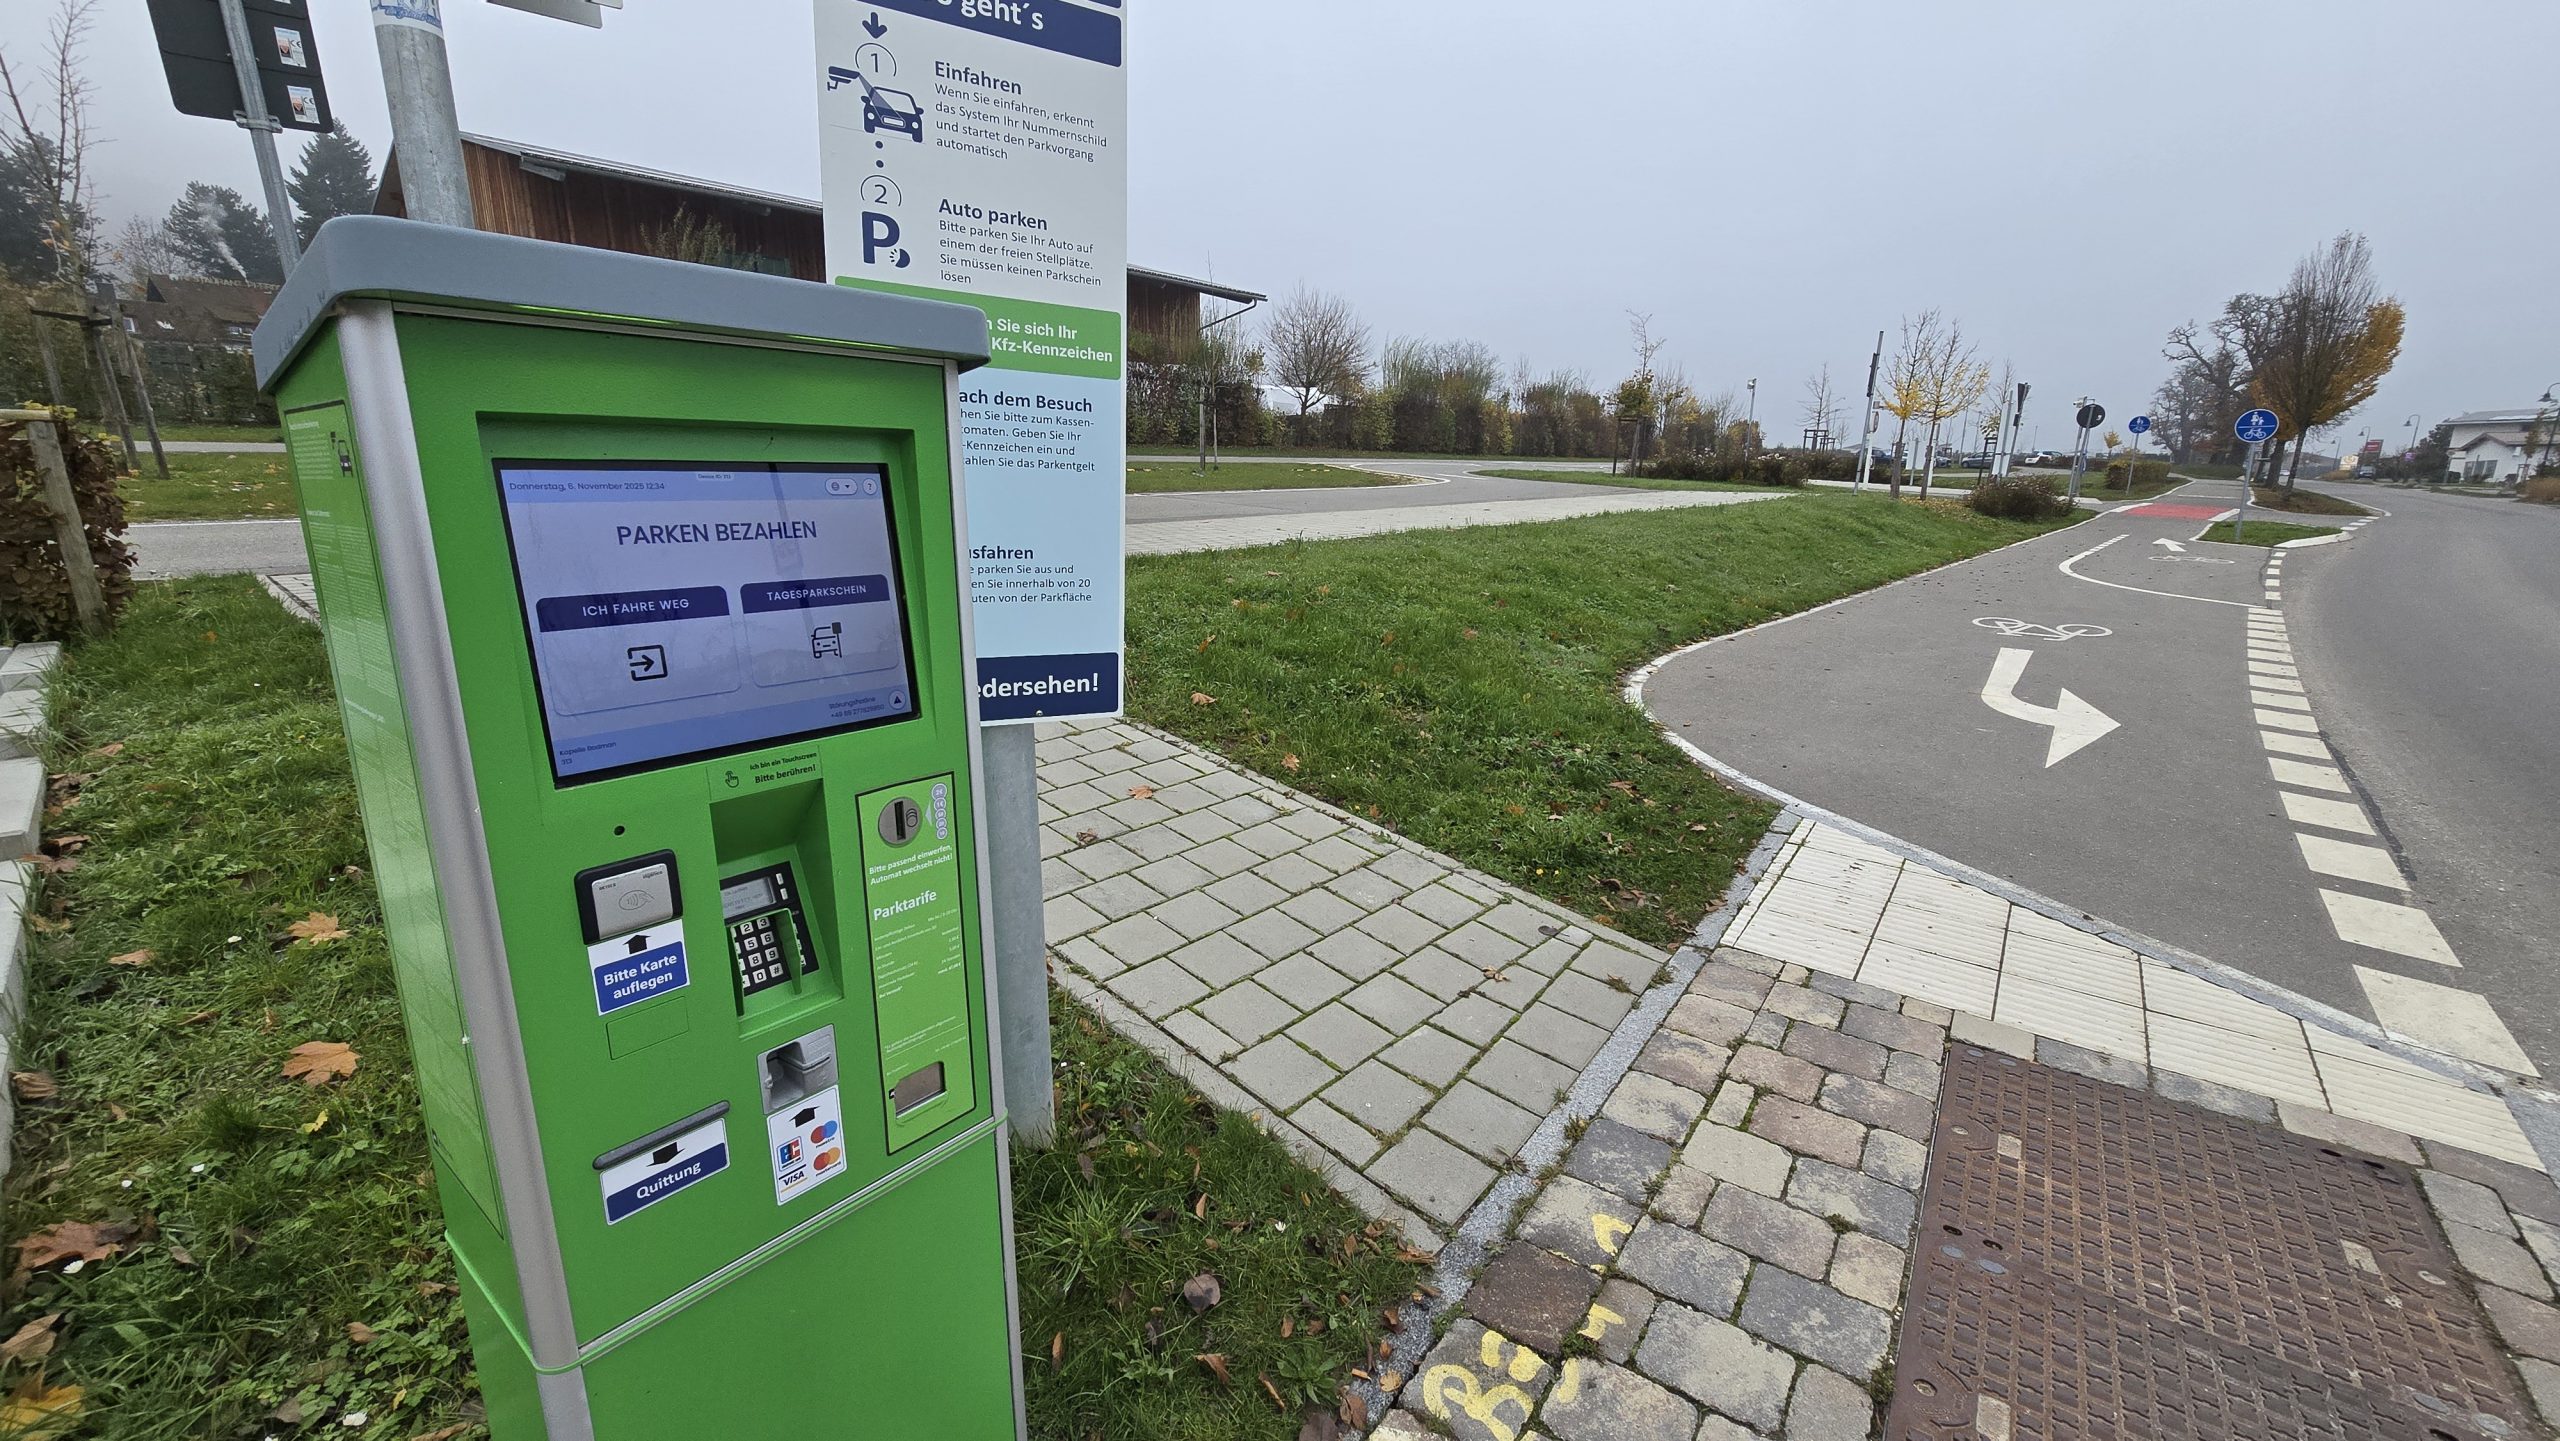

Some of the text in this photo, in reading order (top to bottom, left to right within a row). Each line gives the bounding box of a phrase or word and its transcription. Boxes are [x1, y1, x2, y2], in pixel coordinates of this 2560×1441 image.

[870, 53, 880, 73] 1
[935, 61, 1022, 95] Einfahren
[935, 83, 1094, 128] Wenn Sie einfahren, erkennt
[935, 101, 1107, 147] das System Ihr Nummernschild
[936, 120, 1094, 162] und startet den Parkvorgang
[936, 137, 1008, 159] automatisch
[874, 184, 888, 204] 2
[939, 199, 1048, 230] Auto parken
[939, 220, 1093, 254] Bitte parken Sie Ihr Auto auf
[940, 238, 1093, 269] einem der freien Stellplätze.
[940, 254, 1101, 286] Sie müssen keinen Parkschein
[940, 270, 971, 284] lösen
[997, 318, 1020, 333] Sie
[1024, 322, 1054, 337] sich
[1059, 325, 1077, 340] Ihr
[991, 337, 1113, 362] Kfz-Kennzeichen
[959, 389, 1092, 412] ach dem Besuch
[960, 409, 1094, 427] hen Sie bitte zum Kassen-
[962, 426, 1081, 441] omaten. Geben Sie Ihr
[962, 441, 1075, 455] -Kennzeichen ein und
[963, 456, 1095, 472] ahlen Sie das Parkentgelt
[616, 520, 817, 545] PARKEN BEZAHLEN
[969, 546, 1034, 560] sfahren
[977, 565, 1014, 576] parken
[1016, 564, 1033, 574] Sie
[1034, 566, 1052, 574] aus
[1055, 565, 1074, 573] und
[767, 585, 867, 601] TAGESPARKSCHEIN
[987, 579, 1003, 588] Sie
[1006, 579, 1054, 588] innerhalb
[1058, 580, 1075, 588] von
[1078, 579, 1091, 587] 20
[582, 598, 689, 616] ICH FAHRE WEG
[972, 594, 995, 603] uten
[1021, 593, 1038, 602] der
[1040, 592, 1092, 602] Parkfläche
[976, 673, 1098, 698] dersehen!
[755, 764, 816, 783] Bitte berühren!
[869, 844, 952, 874] Bitte passend einwerfen,
[871, 853, 953, 885] Automat wechselt nicht!
[874, 890, 937, 920] Parktarife
[744, 924, 750, 932] 2
[748, 940, 754, 948] 5
[604, 955, 677, 986] Bitte Karte
[752, 956, 758, 964] 8
[613, 972, 673, 999] auflegen
[636, 1162, 701, 1198] Quittung
[783, 1171, 804, 1186] VISA
